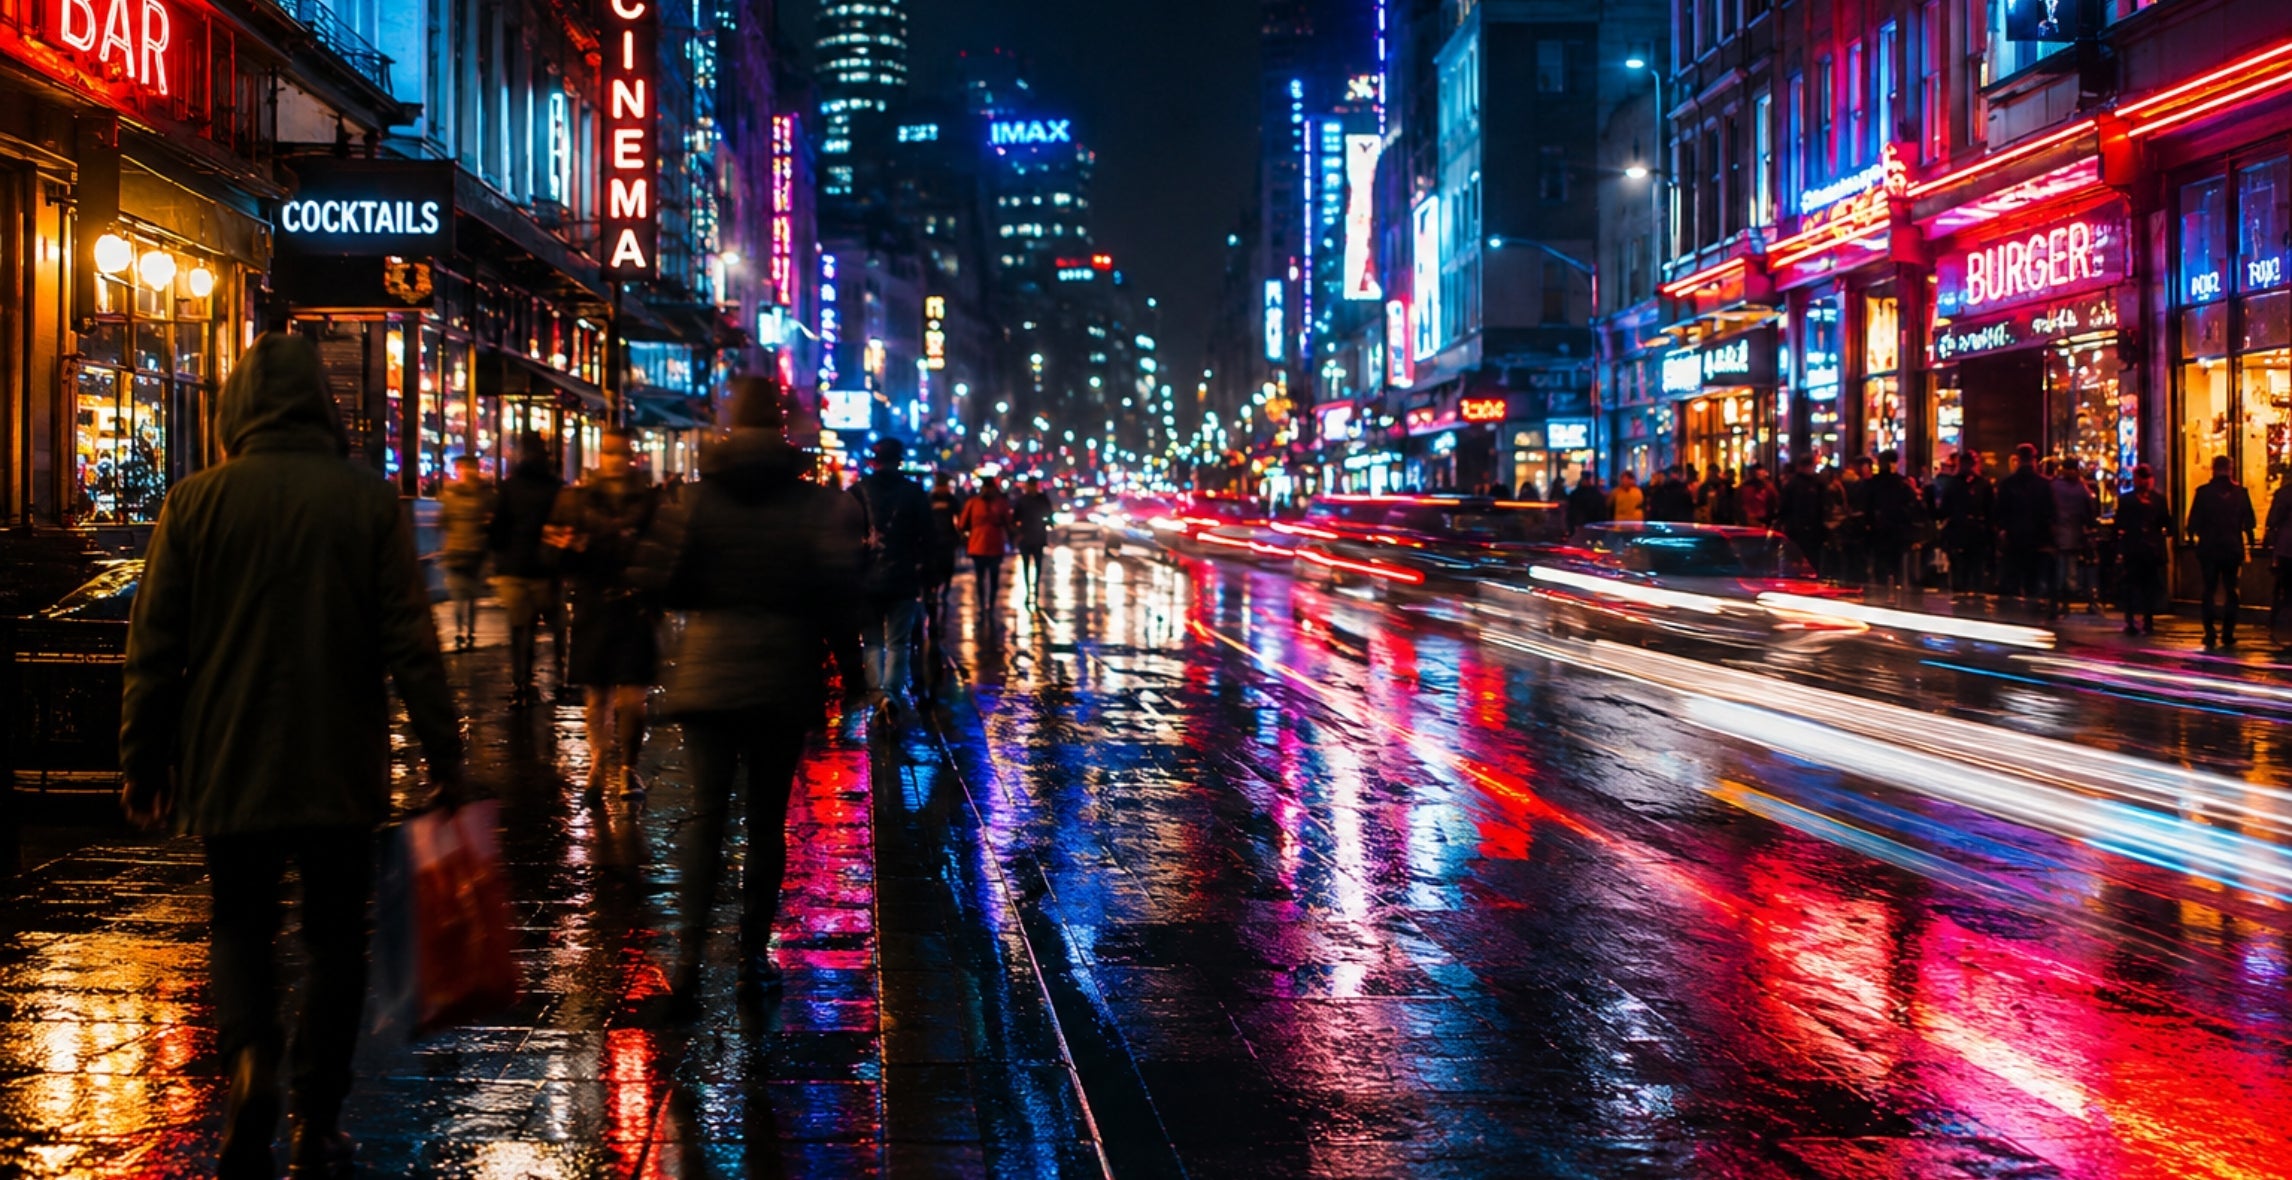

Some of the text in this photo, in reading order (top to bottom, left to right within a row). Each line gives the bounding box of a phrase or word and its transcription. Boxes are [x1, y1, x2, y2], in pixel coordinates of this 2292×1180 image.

[61, 0, 170, 95] BAR
[990, 119, 1071, 144] IMAX
[282, 199, 440, 235] COCKTAILS
[1966, 221, 2091, 306] BURGER
